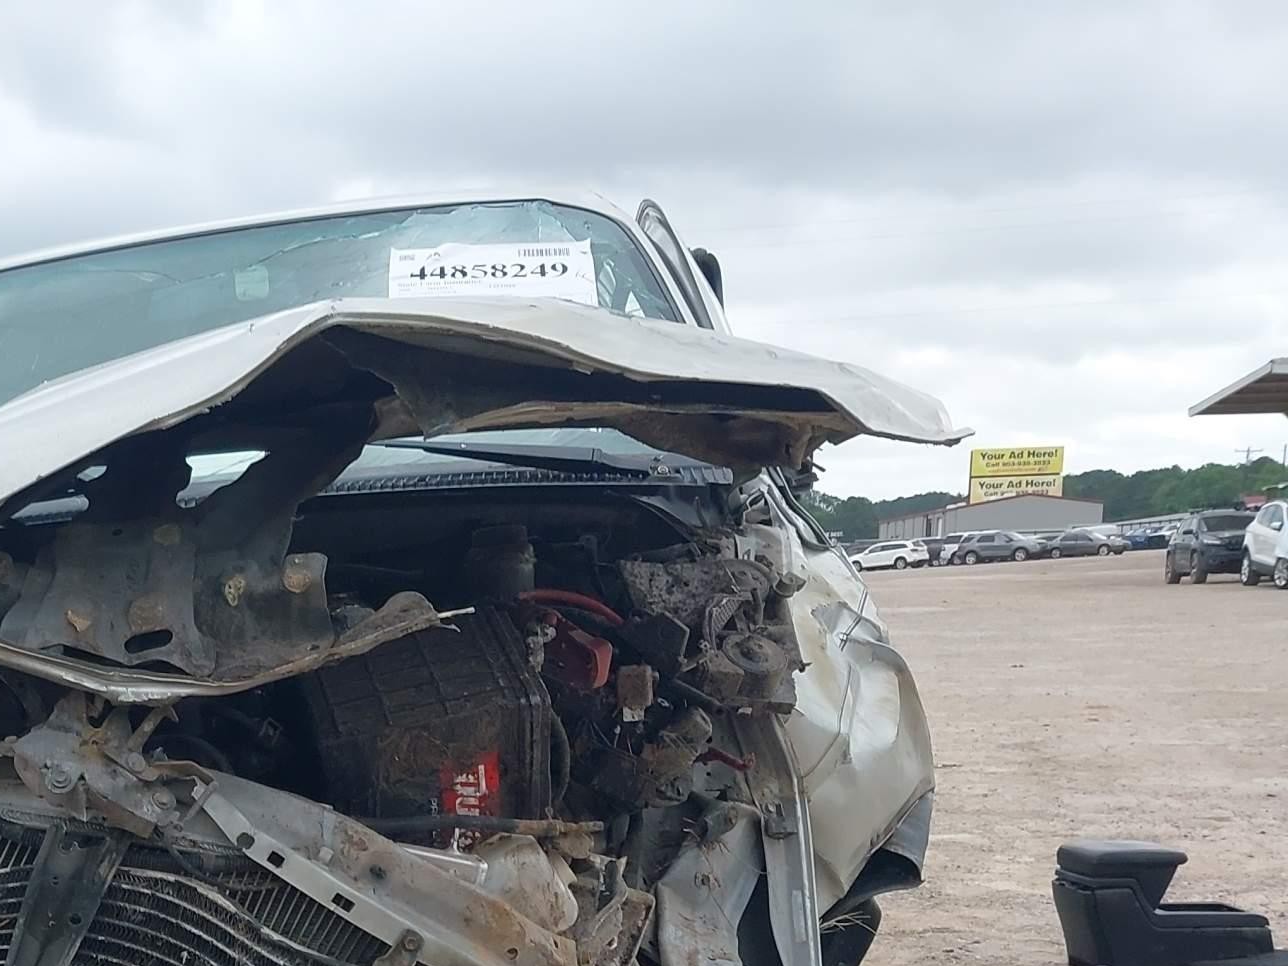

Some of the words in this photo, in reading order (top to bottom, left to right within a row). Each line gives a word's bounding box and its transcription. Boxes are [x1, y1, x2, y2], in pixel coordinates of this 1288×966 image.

[410, 263, 569, 280] 44858249
[980, 452, 1005, 461] Your
[1008, 450, 1024, 459] Ad
[1027, 449, 1058, 459] Here!
[978, 481, 1004, 490] Your
[1007, 480, 1022, 489] Ad
[1025, 479, 1056, 488] Here!
